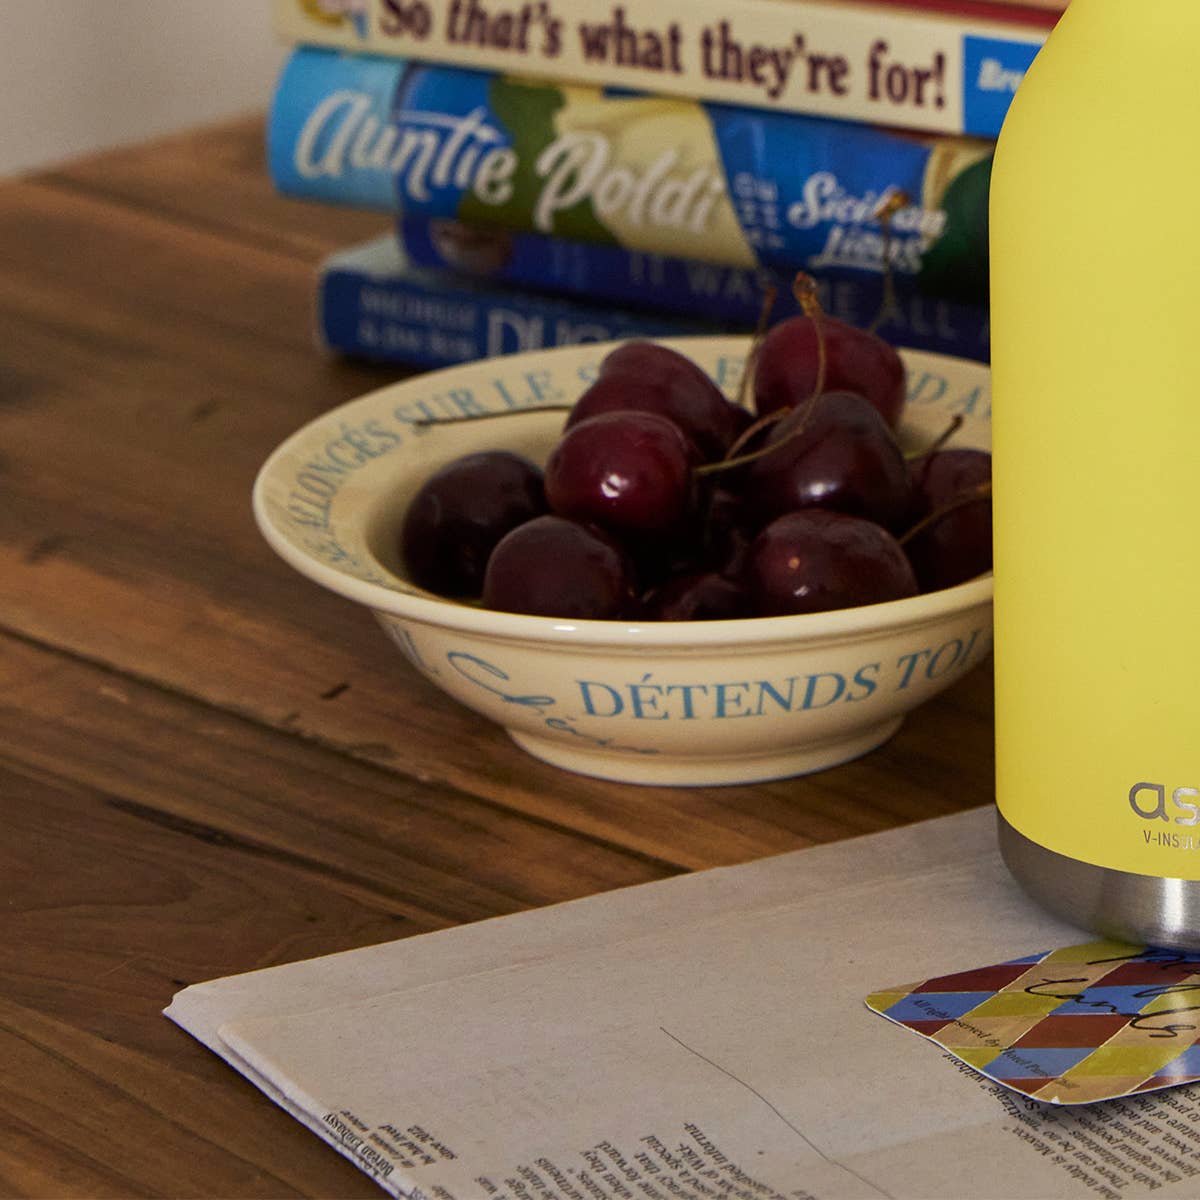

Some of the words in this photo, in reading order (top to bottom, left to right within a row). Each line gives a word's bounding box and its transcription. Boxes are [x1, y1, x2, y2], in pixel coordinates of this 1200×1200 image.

[579, 6, 684, 73] what
[700, 20, 850, 102] they're
[866, 38, 948, 109] for!
[294, 90, 516, 205] Auntie
[535, 130, 729, 234] Poldi
[577, 664, 881, 721] DÉTENDS
